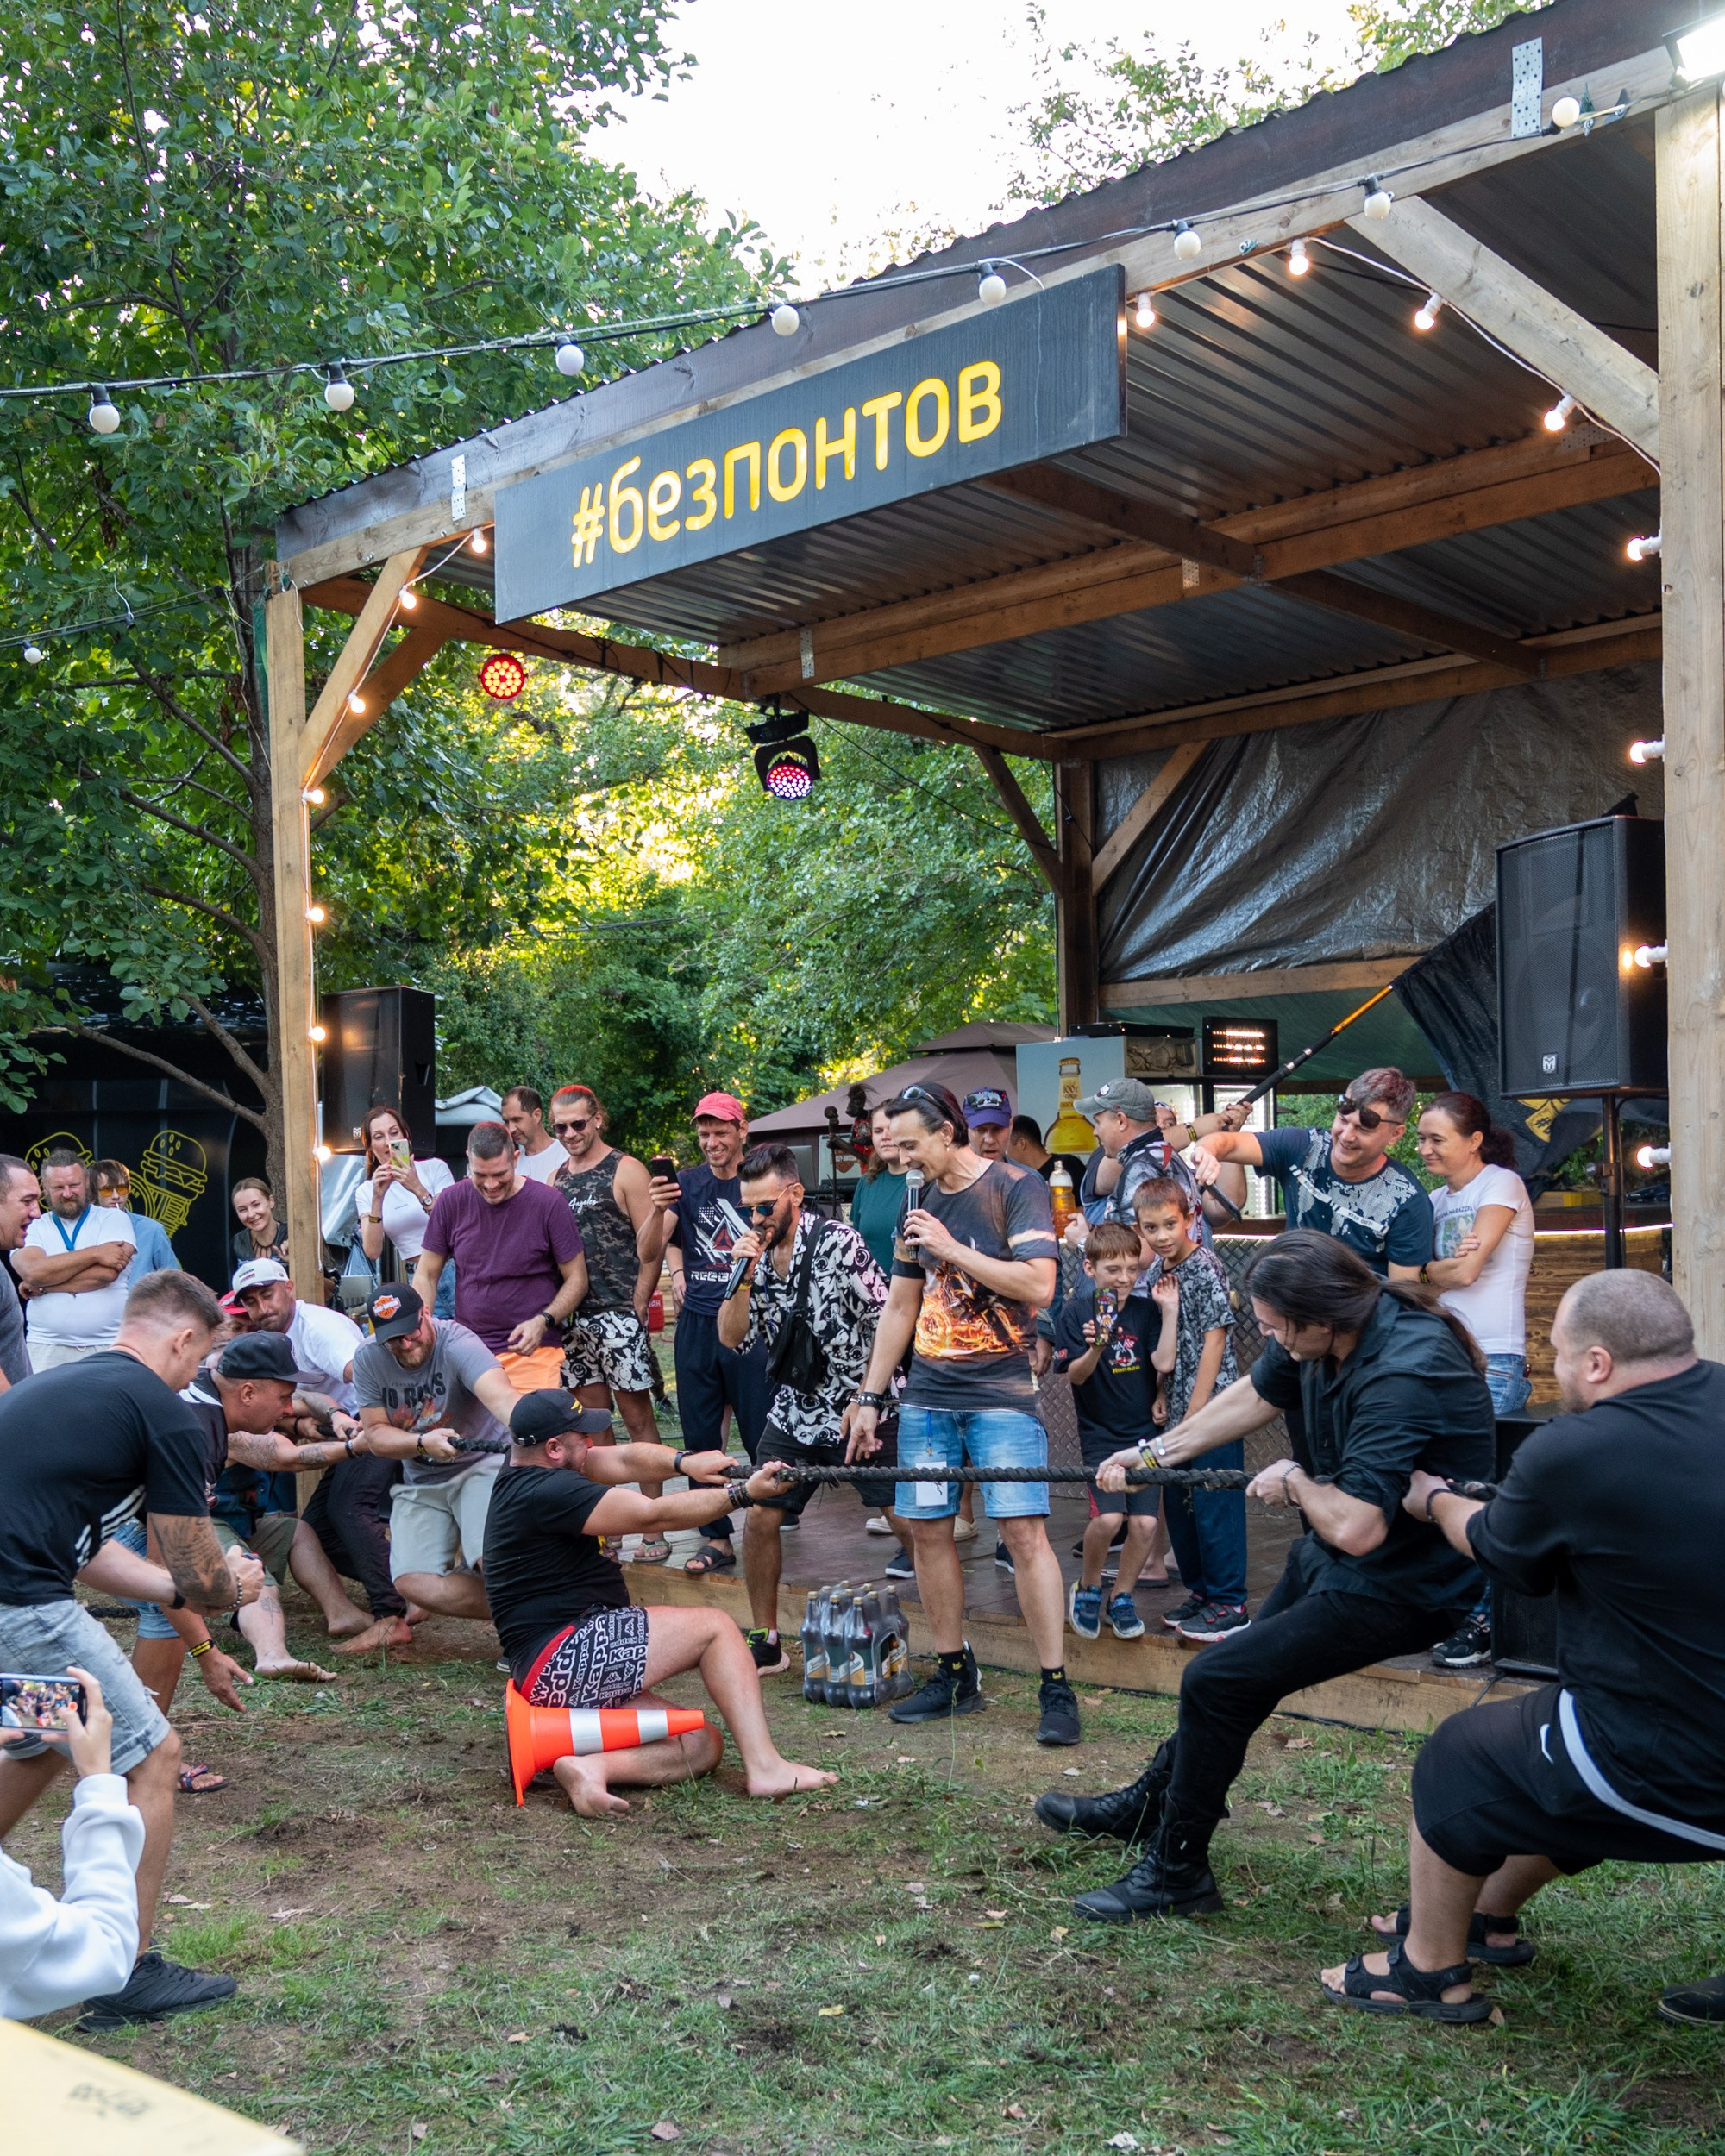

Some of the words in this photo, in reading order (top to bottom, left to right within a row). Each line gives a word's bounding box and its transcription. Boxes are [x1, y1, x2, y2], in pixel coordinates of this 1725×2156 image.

[572, 1639, 589, 1689] Kappa
[581, 1615, 609, 1703] Kappa
[609, 1644, 647, 1664] Kap
